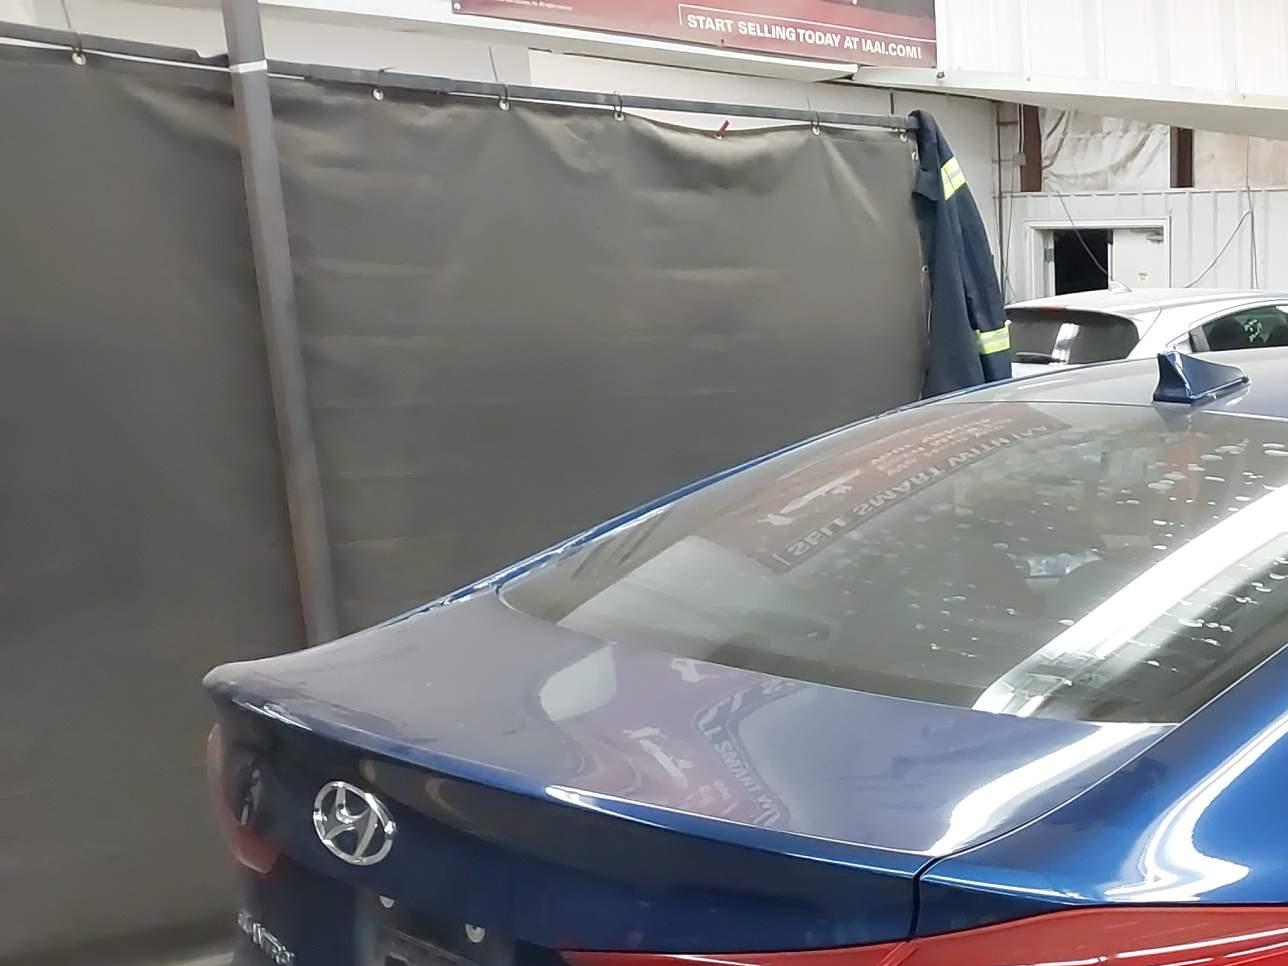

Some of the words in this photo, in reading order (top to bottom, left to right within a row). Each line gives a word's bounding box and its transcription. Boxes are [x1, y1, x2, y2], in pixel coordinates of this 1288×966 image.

[687, 14, 733, 33] START
[738, 20, 796, 41] SELLING
[798, 29, 842, 48] TODAY
[843, 36, 859, 50] AT
[861, 38, 922, 60] IAAI.COM!
